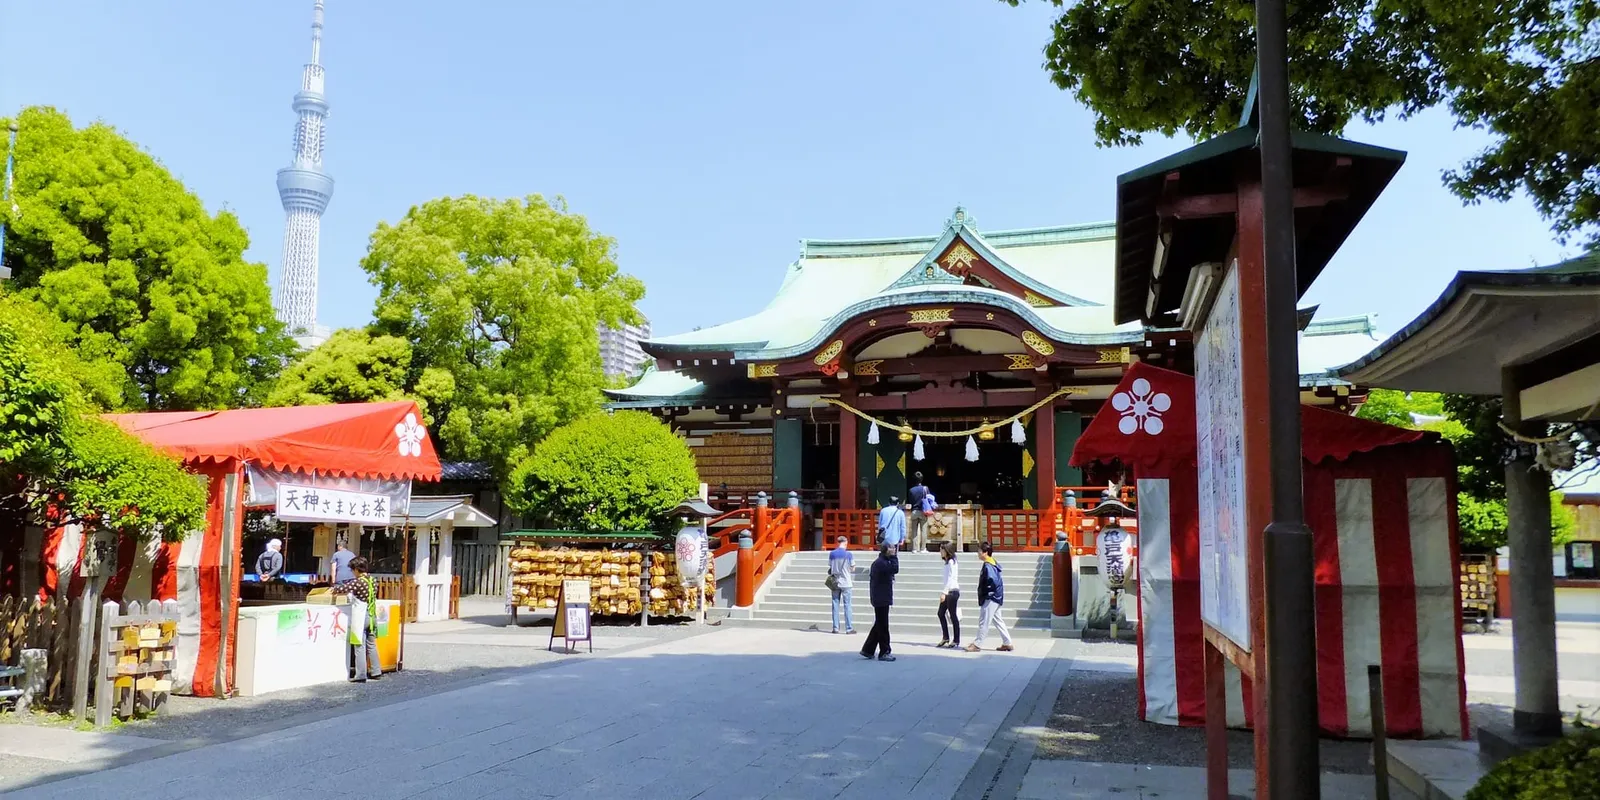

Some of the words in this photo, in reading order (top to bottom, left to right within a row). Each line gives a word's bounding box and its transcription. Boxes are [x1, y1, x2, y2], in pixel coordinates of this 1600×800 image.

[285, 489, 387, 518] 天神さまとお茶
